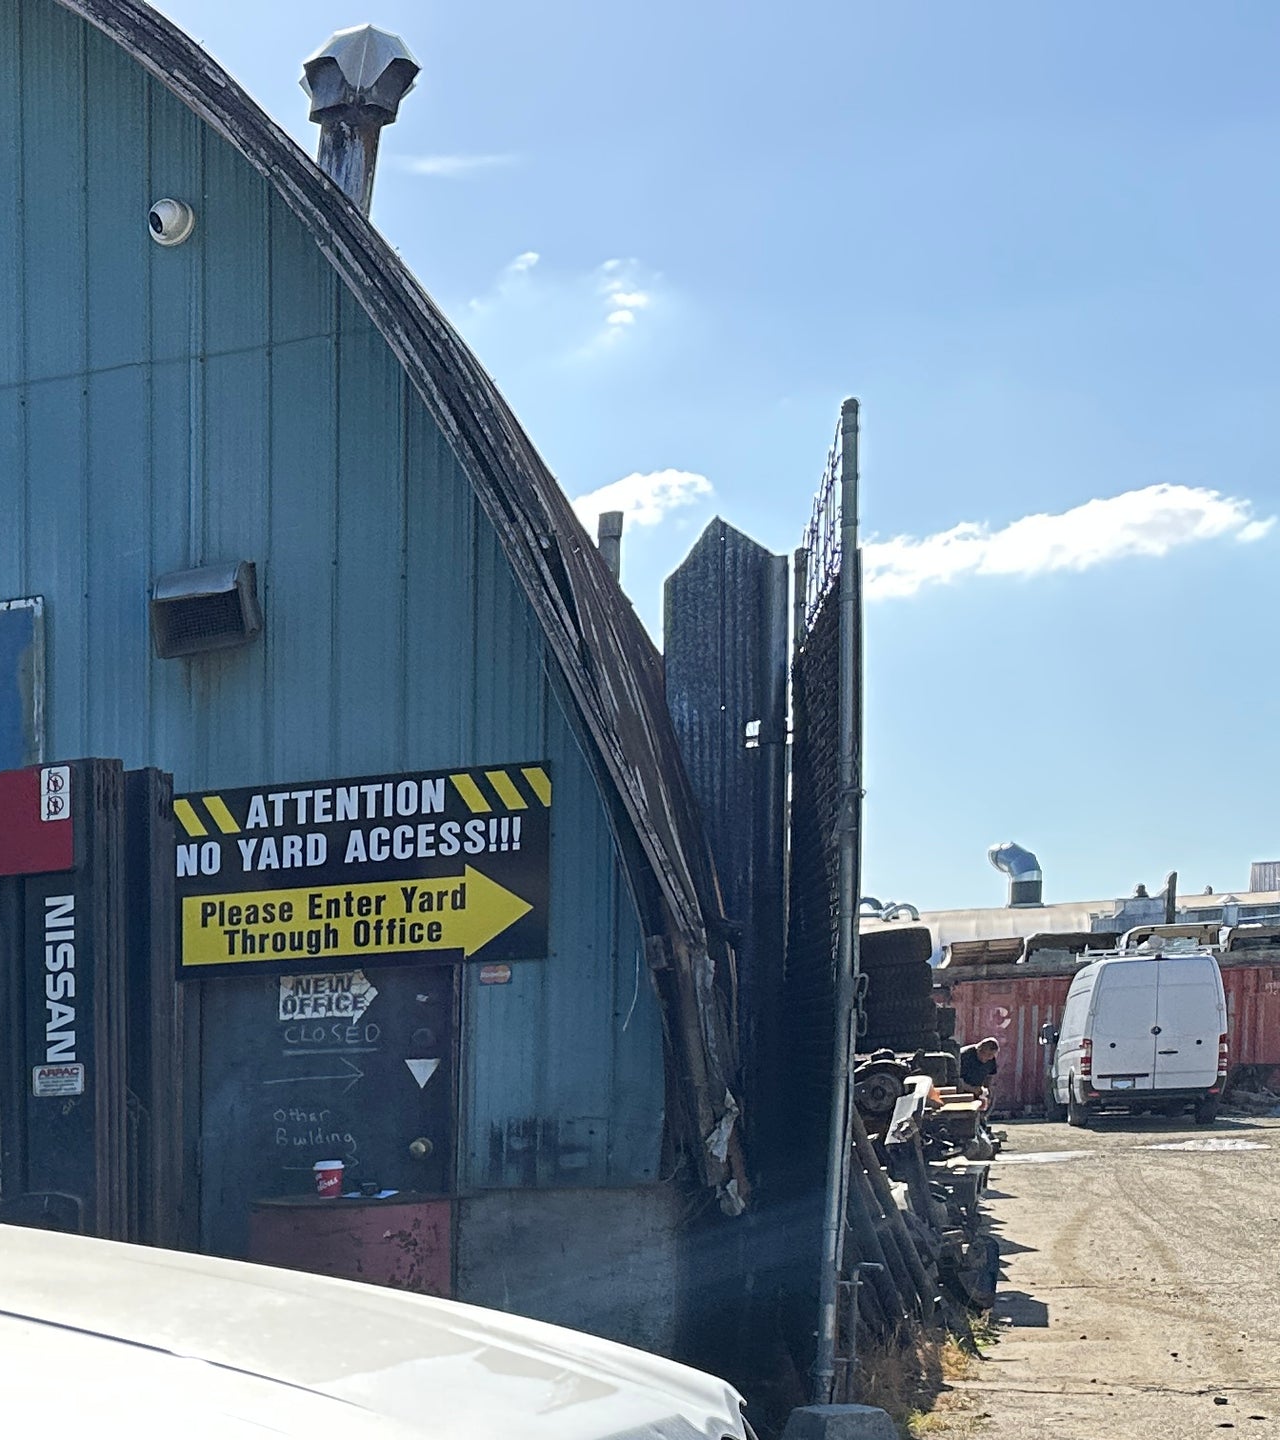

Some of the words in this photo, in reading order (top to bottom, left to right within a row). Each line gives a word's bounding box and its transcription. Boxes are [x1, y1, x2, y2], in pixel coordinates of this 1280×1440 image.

[245, 777, 446, 830] ATTENTION
[176, 841, 221, 877] NO
[237, 832, 327, 872] YARD
[344, 816, 522, 864] ACCESS!!!
[201, 899, 293, 929] Please
[308, 892, 387, 920] Enter
[400, 882, 467, 914] Yard
[223, 923, 340, 956] Through
[353, 920, 443, 948] Office
[44, 894, 76, 1063] NISSAN
[293, 974, 353, 997] NEW
[281, 993, 367, 1017] OFFICE
[284, 1023, 381, 1045] CLOSED
[273, 1108, 331, 1123] Other
